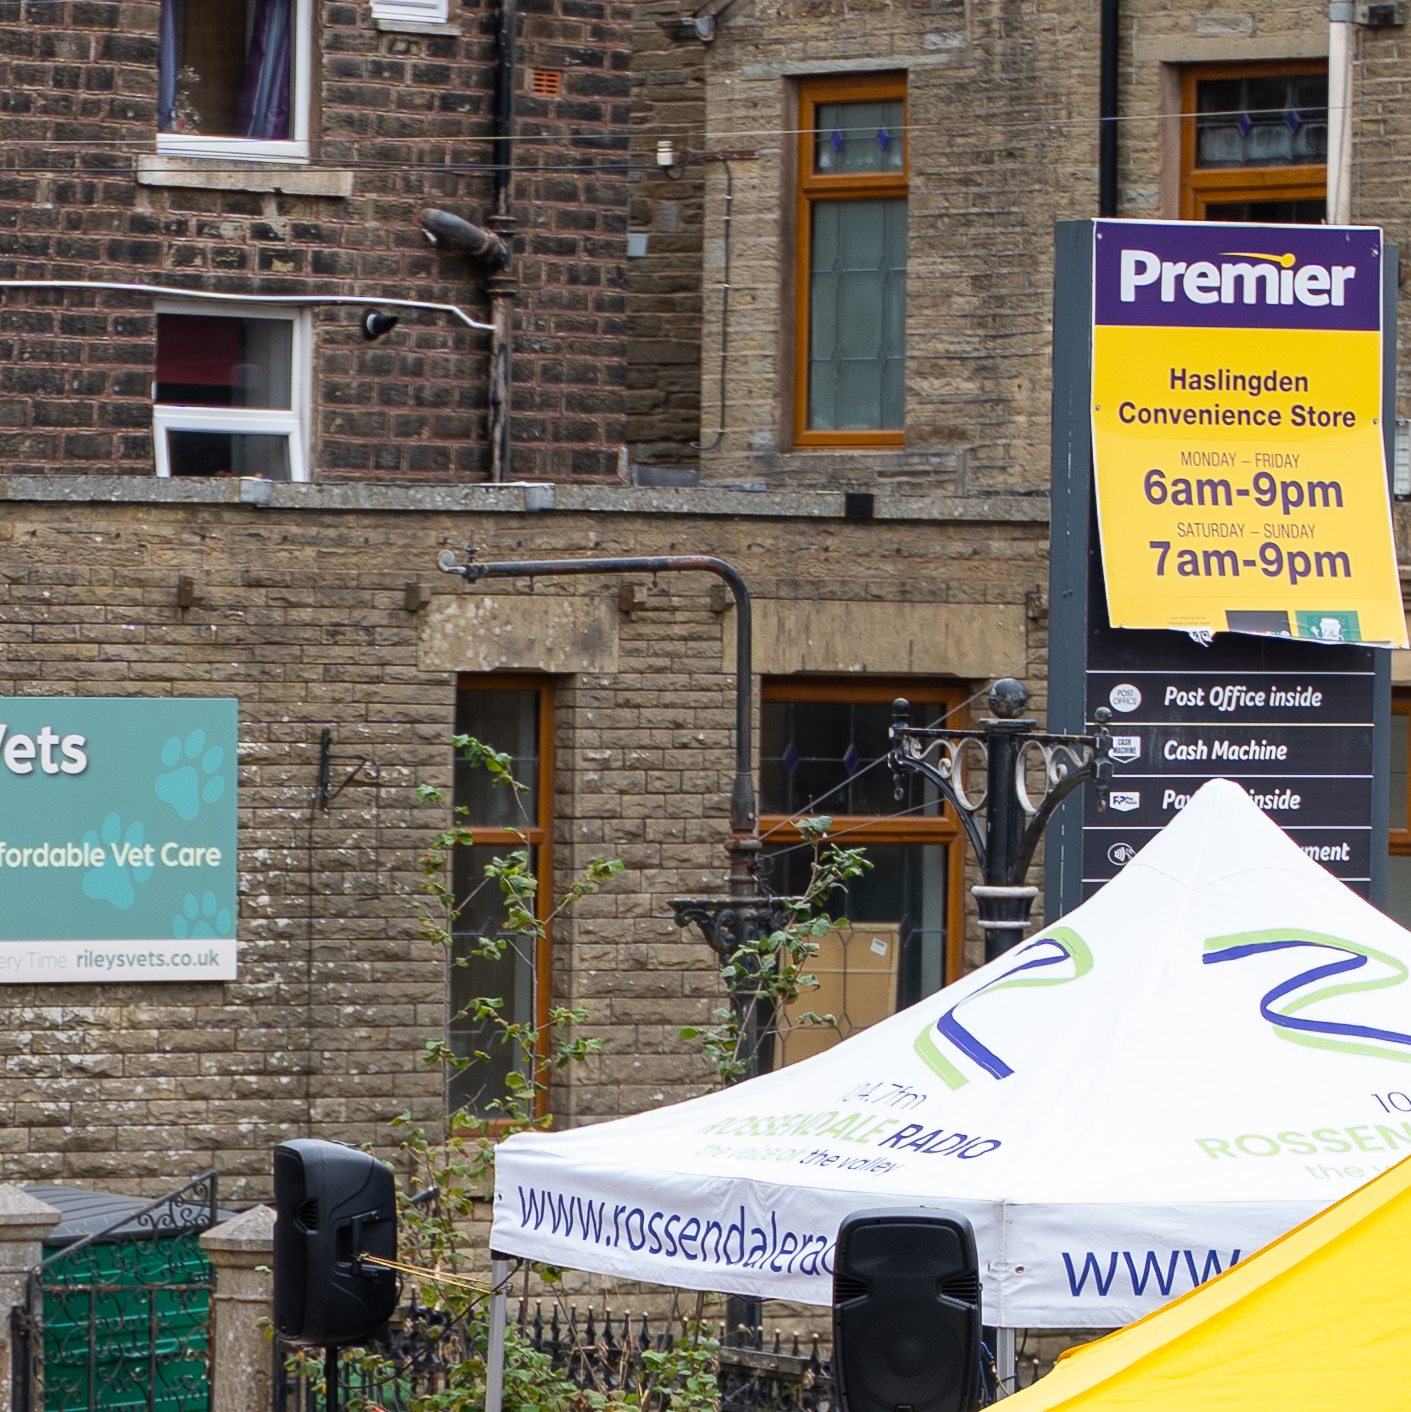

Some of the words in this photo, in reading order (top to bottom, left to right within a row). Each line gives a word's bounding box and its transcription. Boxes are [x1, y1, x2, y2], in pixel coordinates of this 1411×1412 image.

[1120, 249, 1357, 307] Premier
[1170, 368, 1309, 396] Haslingden
[1119, 402, 1282, 427] Convenience
[1290, 404, 1357, 428] Store
[1180, 451, 1237, 468] MONDAY
[1254, 453, 1300, 469] FRIDAY
[1143, 468, 1344, 516] 6am-9pm
[1177, 522, 1246, 539] SATURDAY
[1263, 524, 1316, 540] SUNDAY
[1149, 541, 1353, 586] 7am-9pm
[1164, 686, 1205, 707] Post
[1209, 686, 1266, 712] Office
[1269, 686, 1323, 708] inside
[1163, 739, 1209, 761] Cash
[1211, 740, 1288, 762] Machine
[110, 842, 156, 868] Vet
[160, 842, 223, 868] Care
[26, 951, 68, 969] Time
[75, 949, 220, 970] rileysvets.co.uk
[693, 1110, 901, 1145] ROSSENDALE
[876, 1123, 1002, 1160] RADIO
[798, 1149, 835, 1168] the
[836, 1155, 906, 1178] valley
[1304, 1164, 1366, 1180] the
